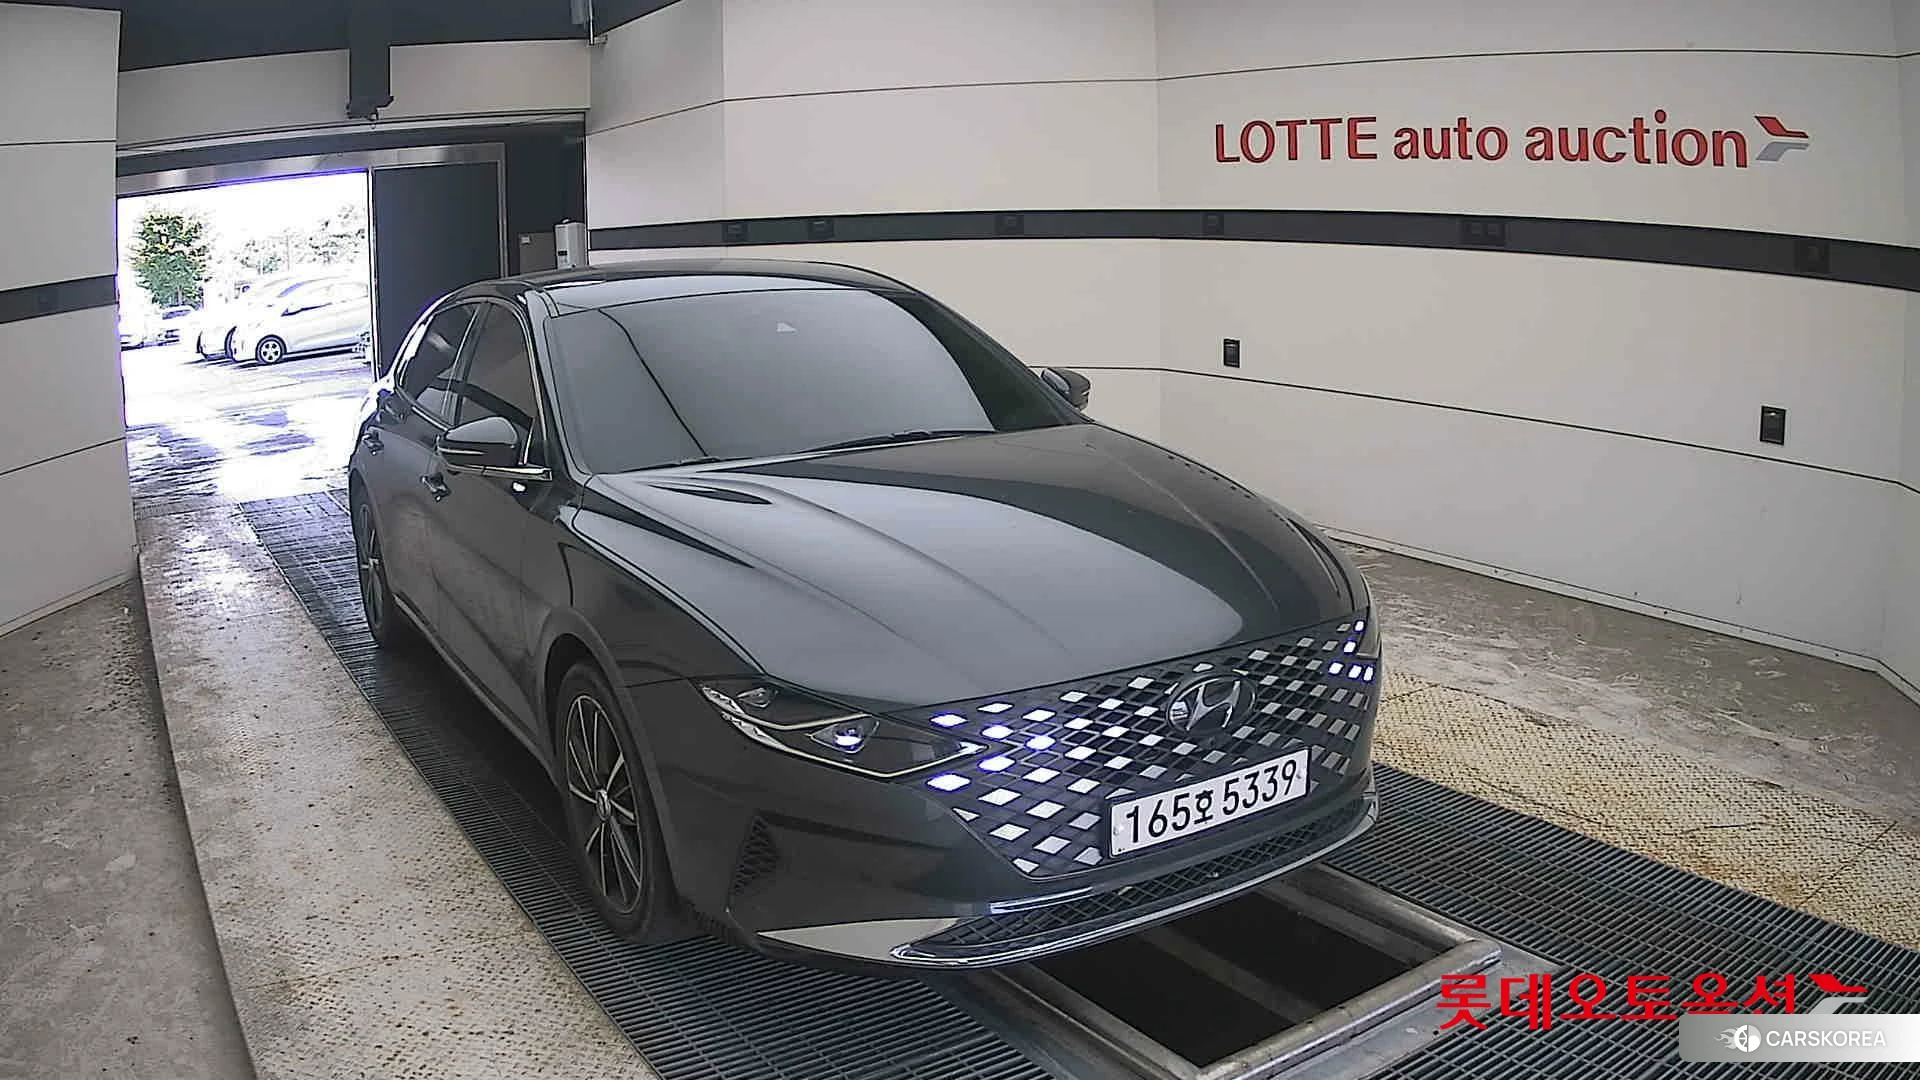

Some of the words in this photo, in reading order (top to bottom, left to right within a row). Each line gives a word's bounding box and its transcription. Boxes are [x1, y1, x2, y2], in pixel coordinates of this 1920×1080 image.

[1215, 116, 1377, 162] LOTTE
[1393, 117, 1508, 160] auto
[1525, 109, 1748, 168] auction
[1223, 759, 1297, 816] 5339
